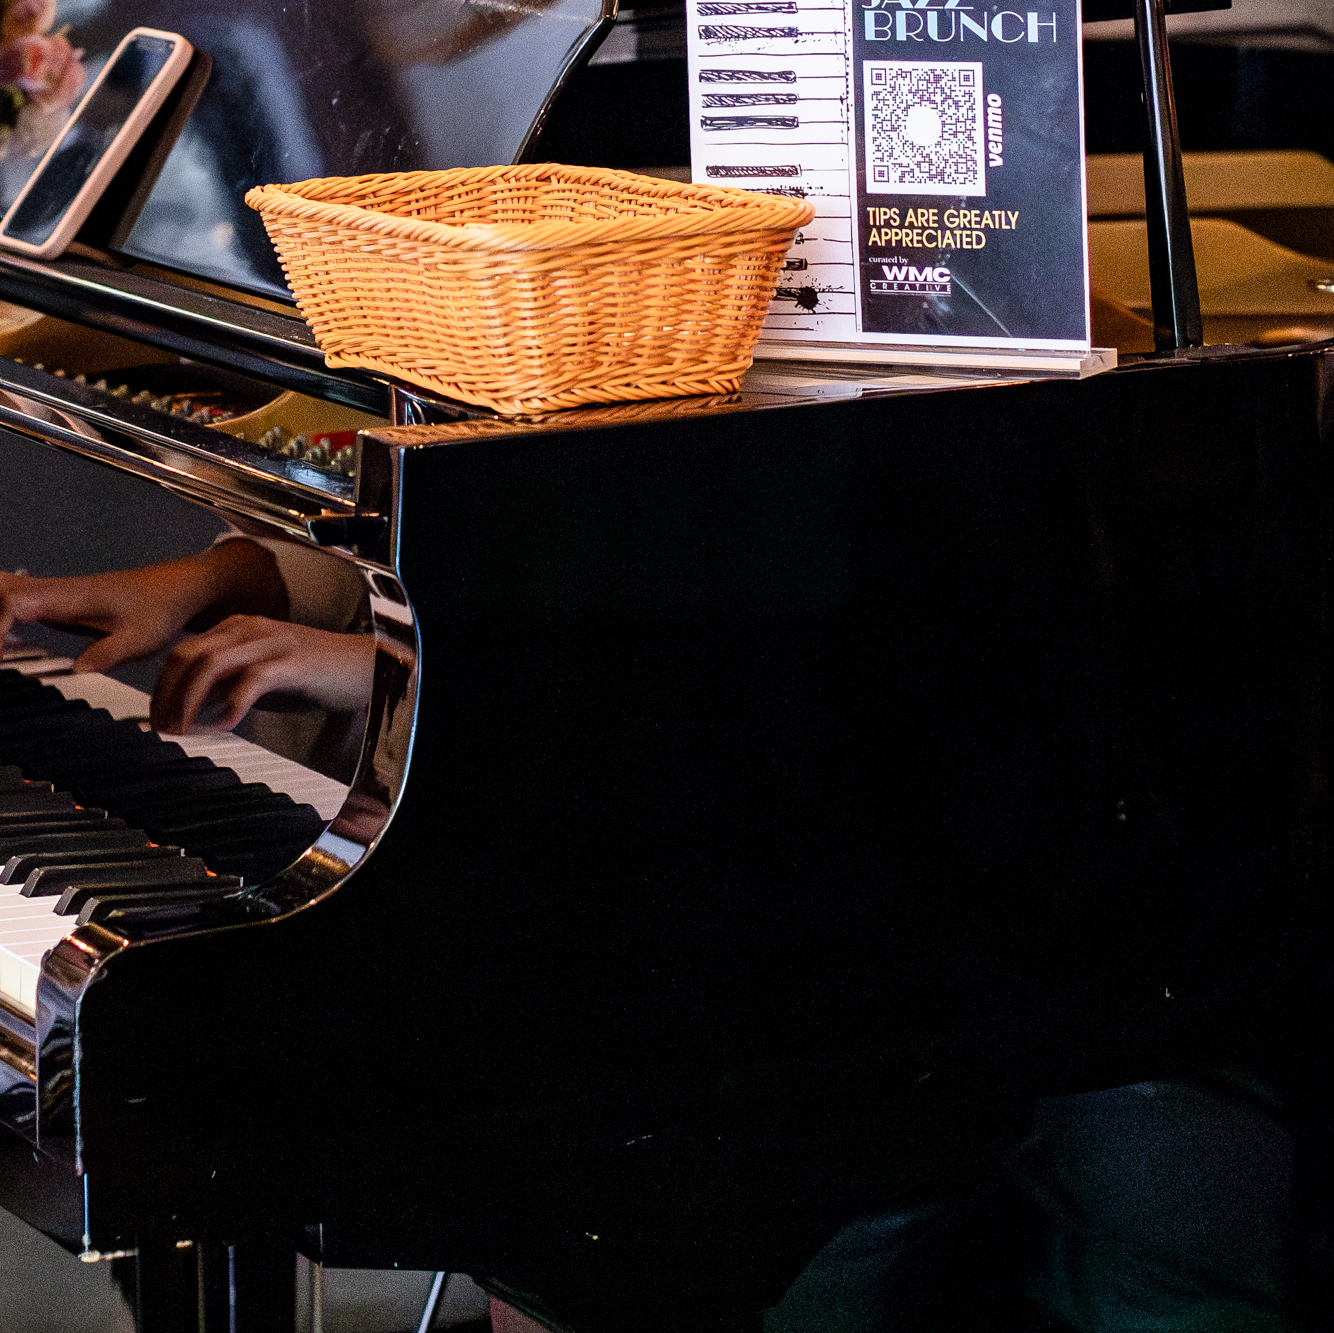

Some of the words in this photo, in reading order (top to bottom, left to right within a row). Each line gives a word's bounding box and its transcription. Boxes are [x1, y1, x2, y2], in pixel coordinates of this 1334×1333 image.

[864, 10, 1057, 43] BRUNCH
[986, 93, 1004, 167] venmo
[867, 207, 900, 226] TIPS
[905, 208, 938, 227] ARE
[943, 209, 1019, 230] GREATLY
[868, 228, 986, 249] APPRECIATED
[868, 256, 898, 264] curated
[898, 256, 909, 265] by
[881, 265, 951, 282] WMC
[869, 282, 952, 292] CREATIVE
